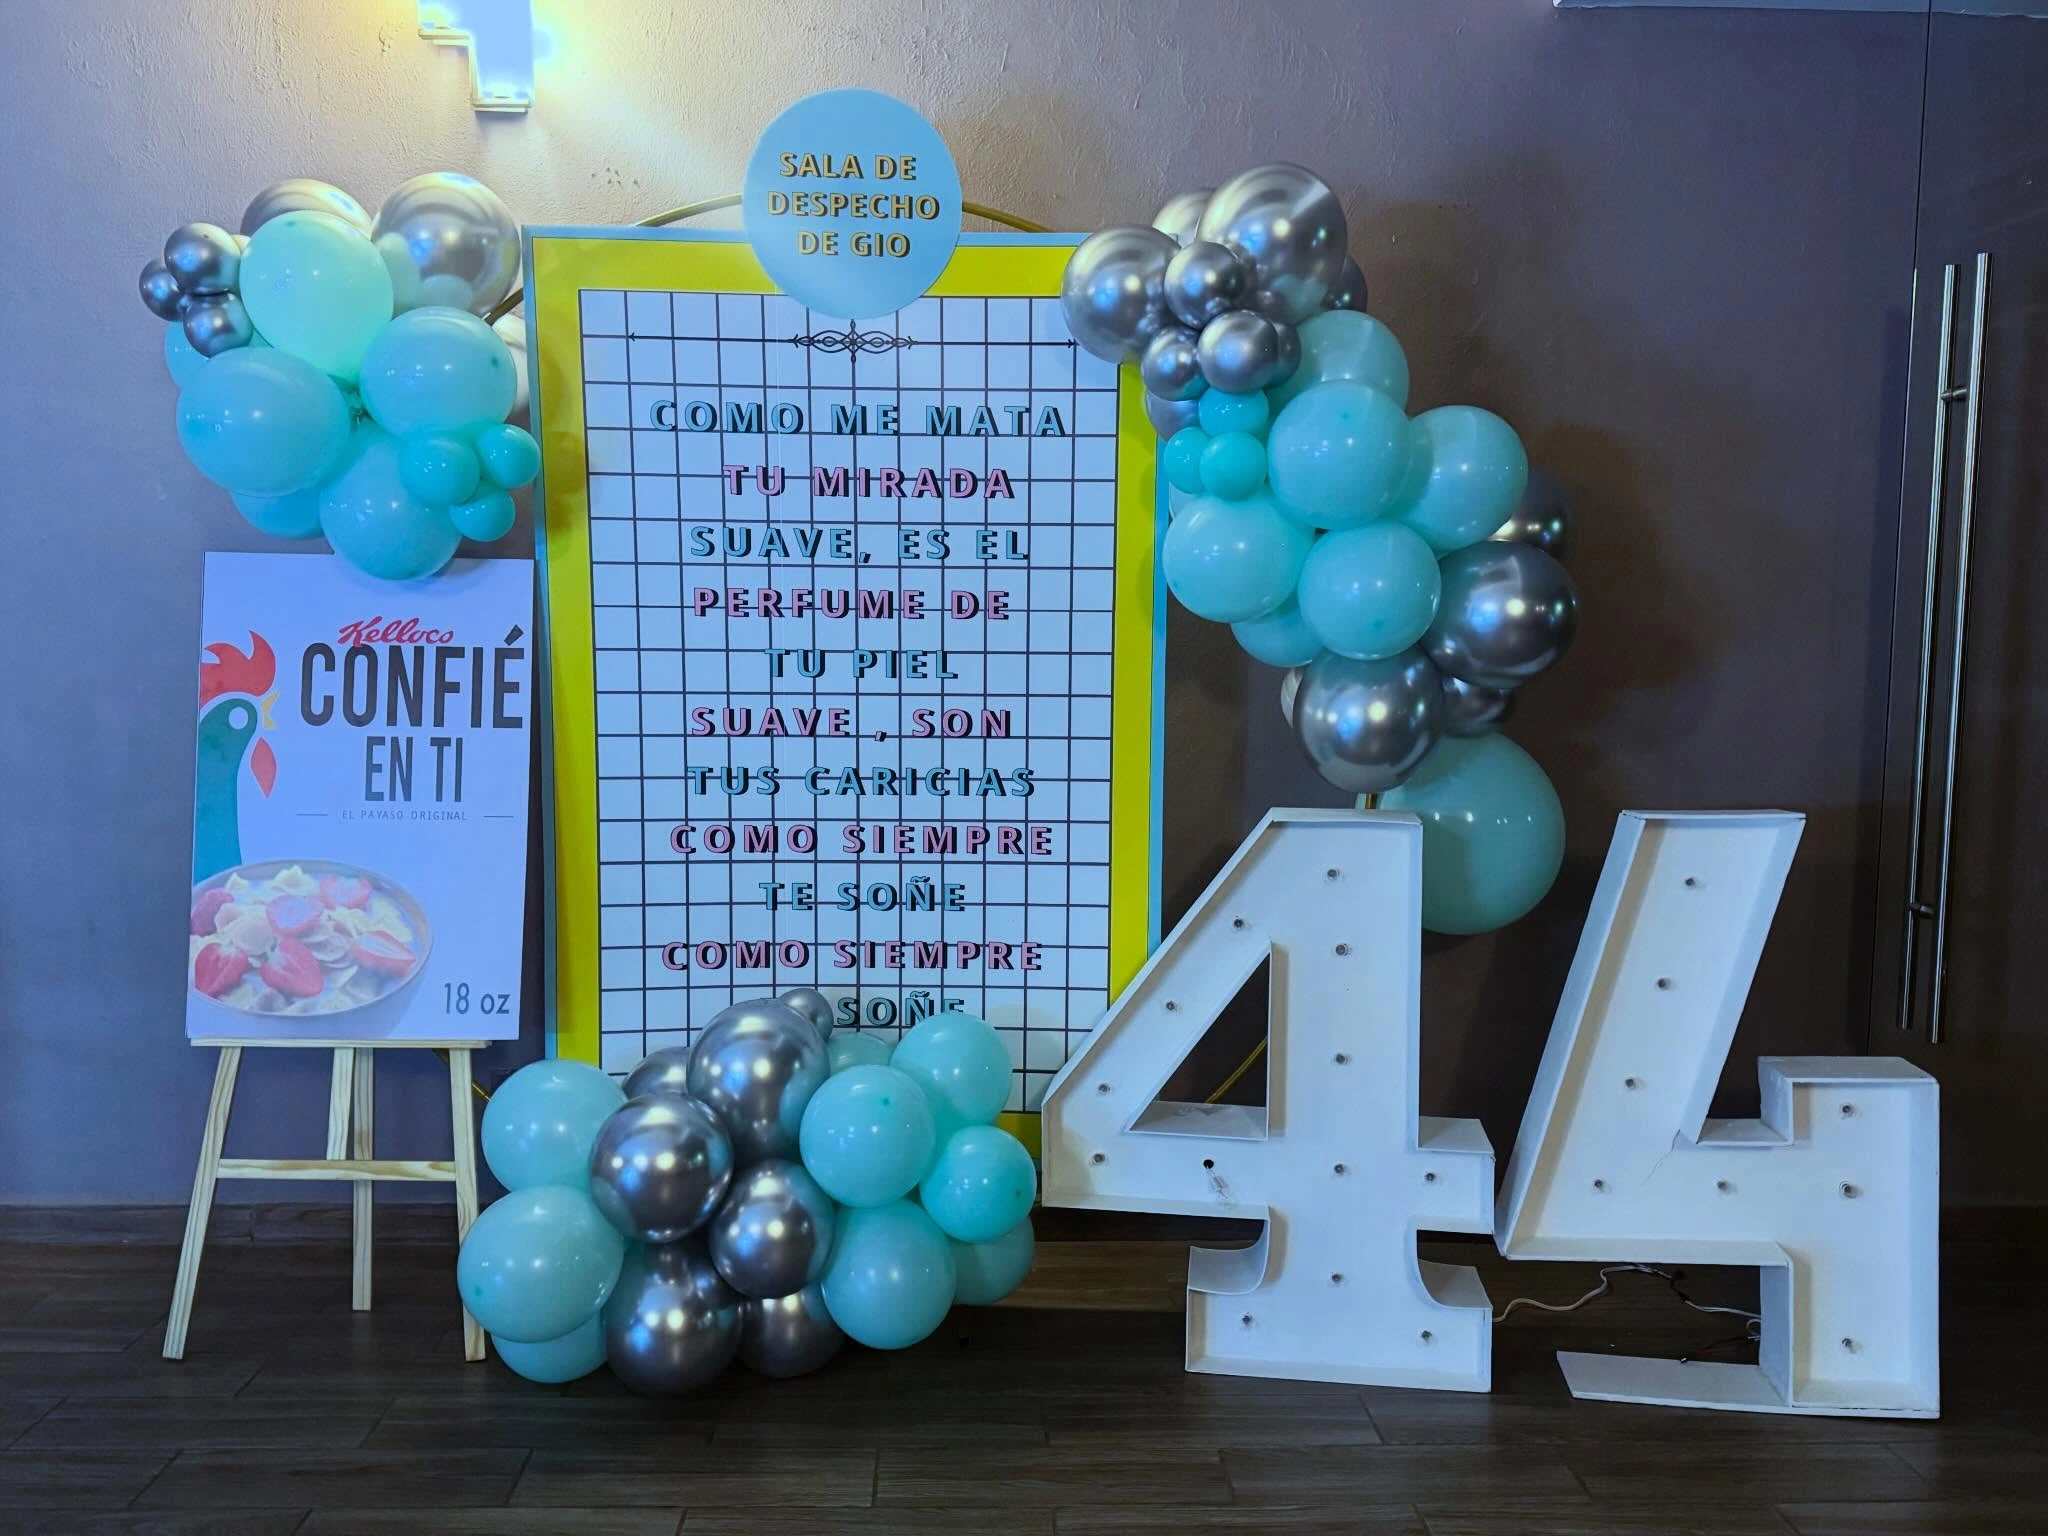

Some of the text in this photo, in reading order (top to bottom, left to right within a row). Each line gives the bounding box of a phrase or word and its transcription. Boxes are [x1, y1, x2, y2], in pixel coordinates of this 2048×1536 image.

[780, 152, 917, 180] SALA DE
[767, 191, 940, 220] DESPECHO
[797, 231, 911, 257] DE GIO
[649, 399, 1067, 437] COMO ME MATA
[722, 465, 1015, 499] TU MIRADA
[690, 526, 1029, 564] SUAVE, ES EL
[693, 587, 1011, 621] PERFUME DE
[301, 624, 524, 728] CONFIÉ
[764, 649, 959, 680] TU PIEL
[691, 707, 850, 737] SUAVE
[912, 708, 1012, 739] SON
[365, 736, 463, 803] EN TI
[686, 766, 1036, 798] TUS CARICIAS
[342, 810, 467, 821] EL PAYASO ORIGINAL
[670, 824, 1053, 856] COMO SIEMPRE
[759, 876, 967, 912] TE SOÑE
[661, 940, 1044, 972] COMO SIEMPRE
[444, 982, 511, 1014] 18 oz
